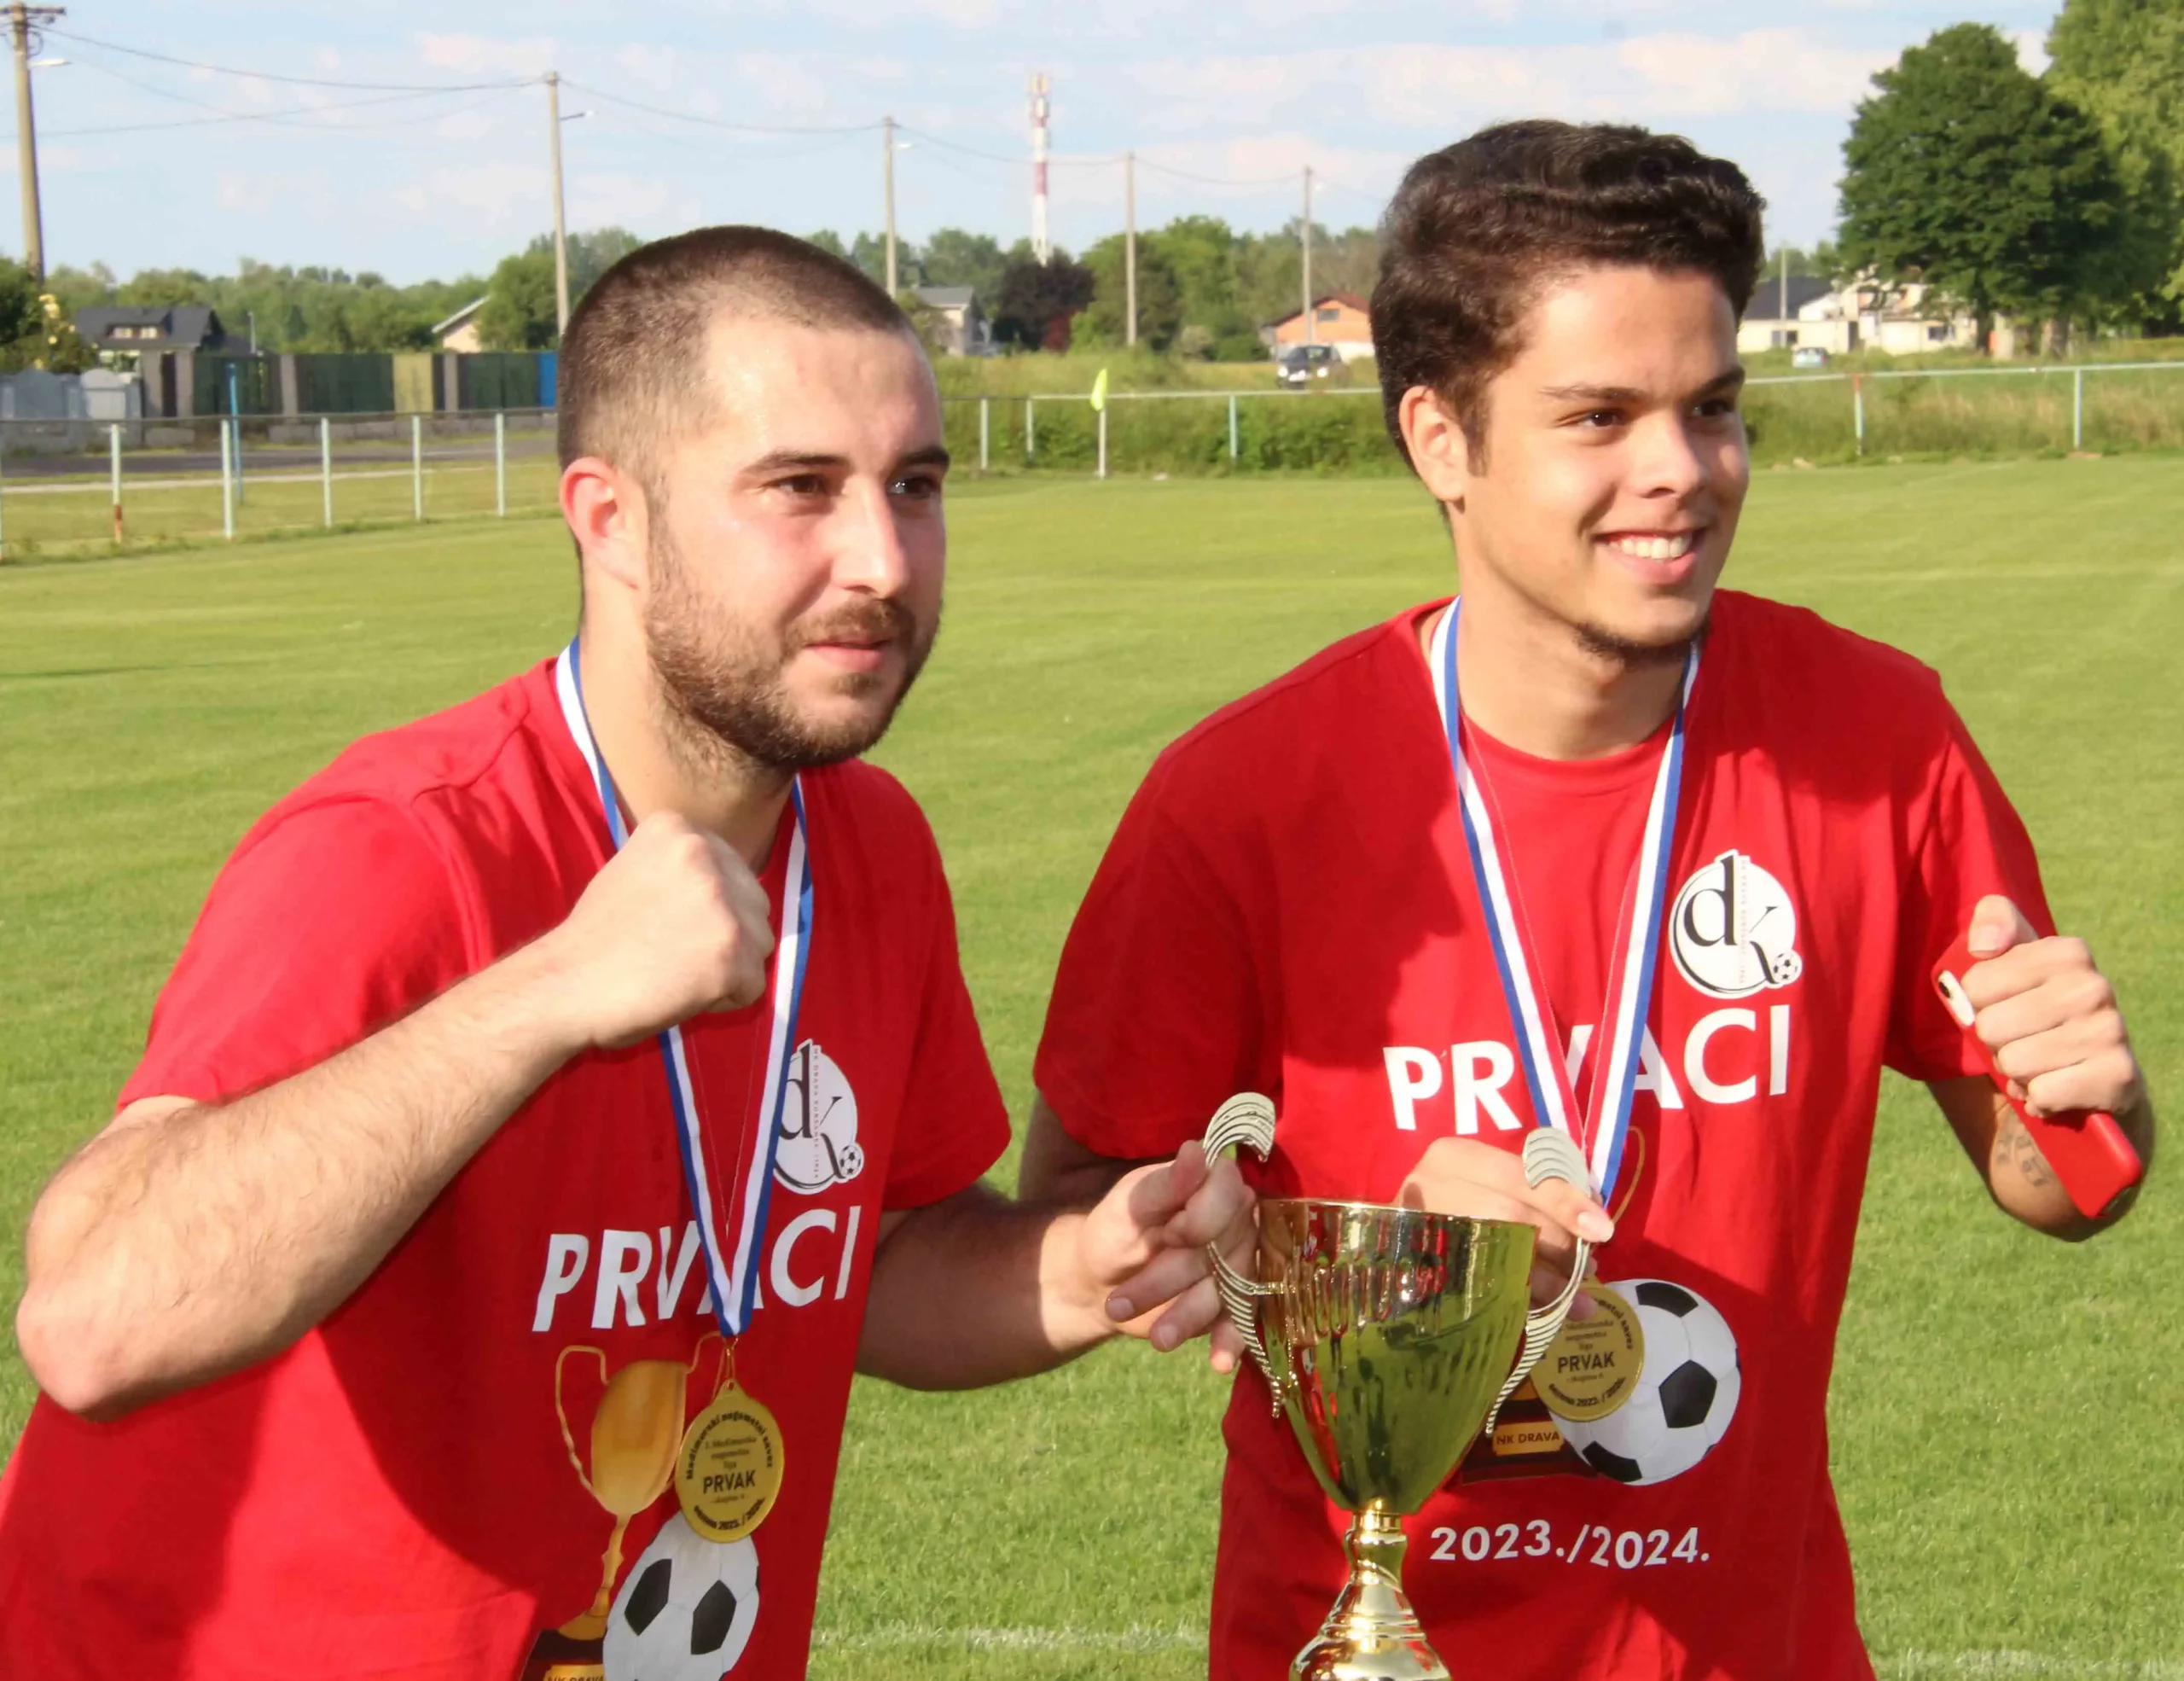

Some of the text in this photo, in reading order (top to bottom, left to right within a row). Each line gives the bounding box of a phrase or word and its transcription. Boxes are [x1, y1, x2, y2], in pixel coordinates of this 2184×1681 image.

[1557, 1351, 1615, 1373] PRVAK
[1496, 1431, 1560, 1445] NK DRAVA
[703, 1469, 756, 1494] PRVAK
[1430, 1520, 1711, 1569] 2023./2024.
